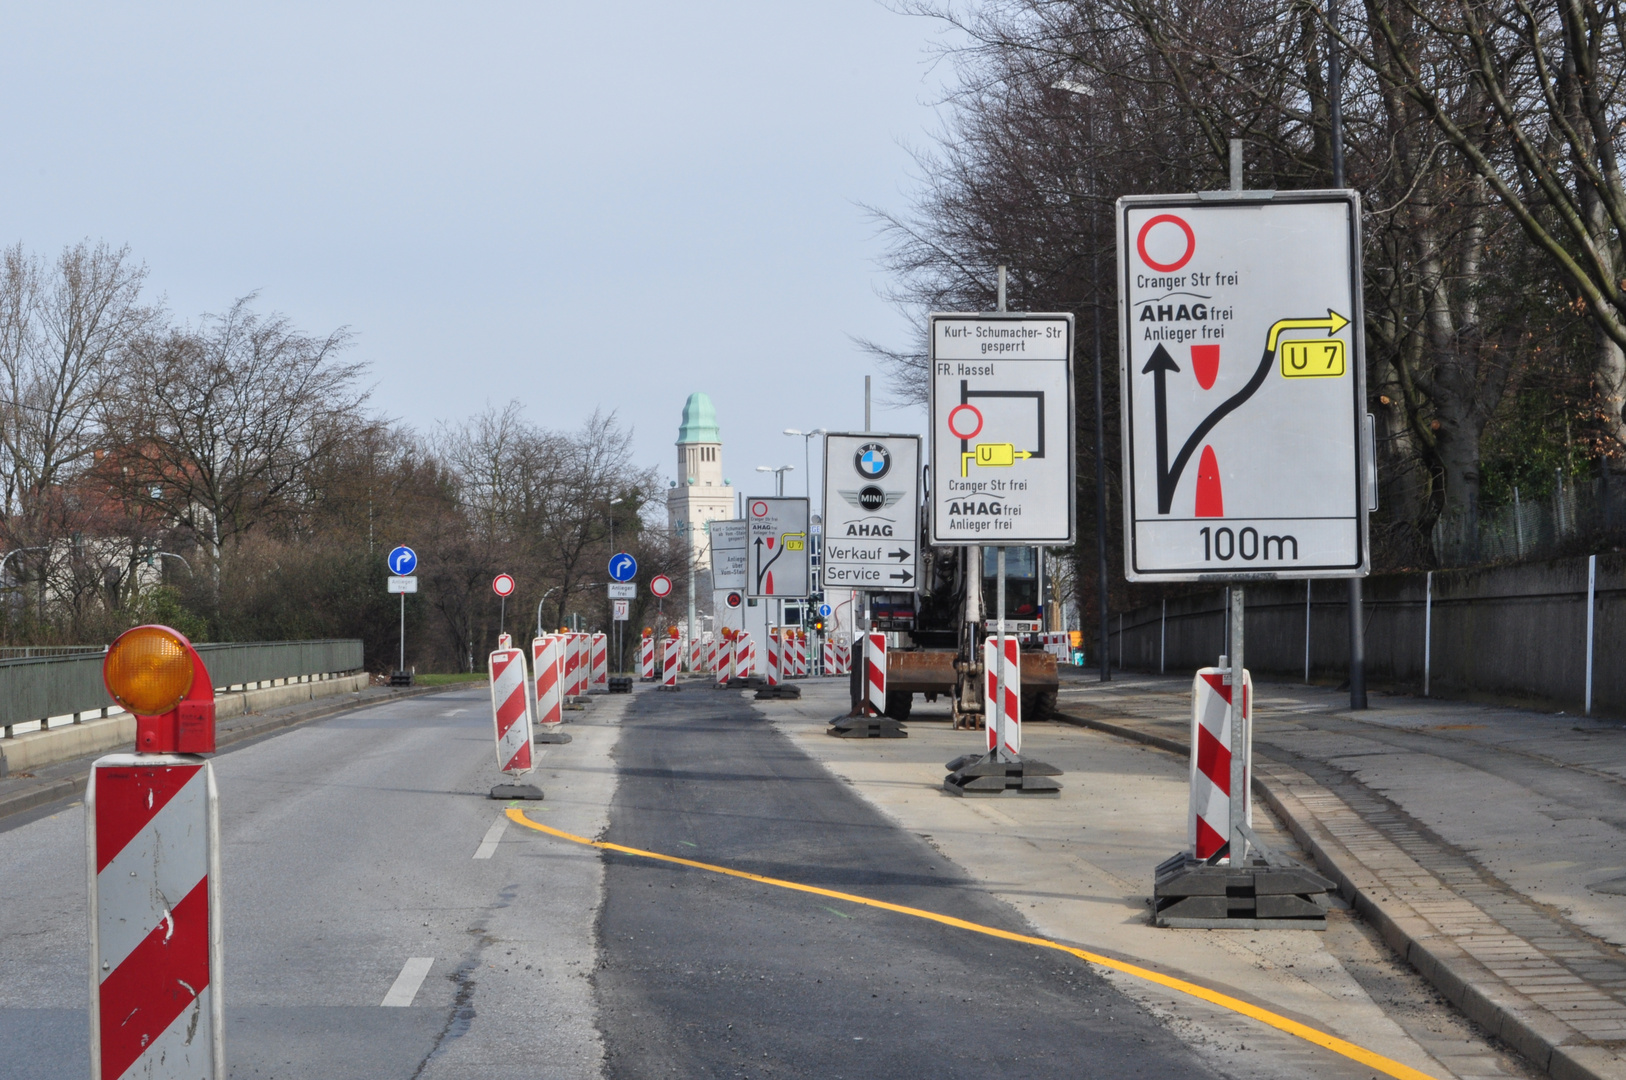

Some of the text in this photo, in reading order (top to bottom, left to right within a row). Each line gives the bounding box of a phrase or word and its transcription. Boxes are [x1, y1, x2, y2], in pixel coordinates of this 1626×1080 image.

[1137, 271, 1239, 291] Cranger Str frei
[1139, 303, 1233, 322] AHAG frei
[1046, 326, 1062, 339] Str
[1144, 324, 1225, 344] Anlieger frei
[981, 341, 1026, 354] gesperrt
[1290, 346, 1338, 370] U 7
[937, 363, 995, 376] FR. Hassel
[858, 444, 888, 457] BMW
[981, 447, 992, 462] U
[949, 479, 1028, 494] Cranger Str frei
[861, 494, 882, 503] MINI
[949, 502, 1022, 516] AHAG frei
[846, 524, 893, 537] AHAG
[949, 518, 1013, 532] Anlieger frei
[788, 541, 795, 549] U
[1199, 526, 1298, 561] 100m
[828, 546, 882, 560] Verkauf
[827, 566, 880, 580] Service
